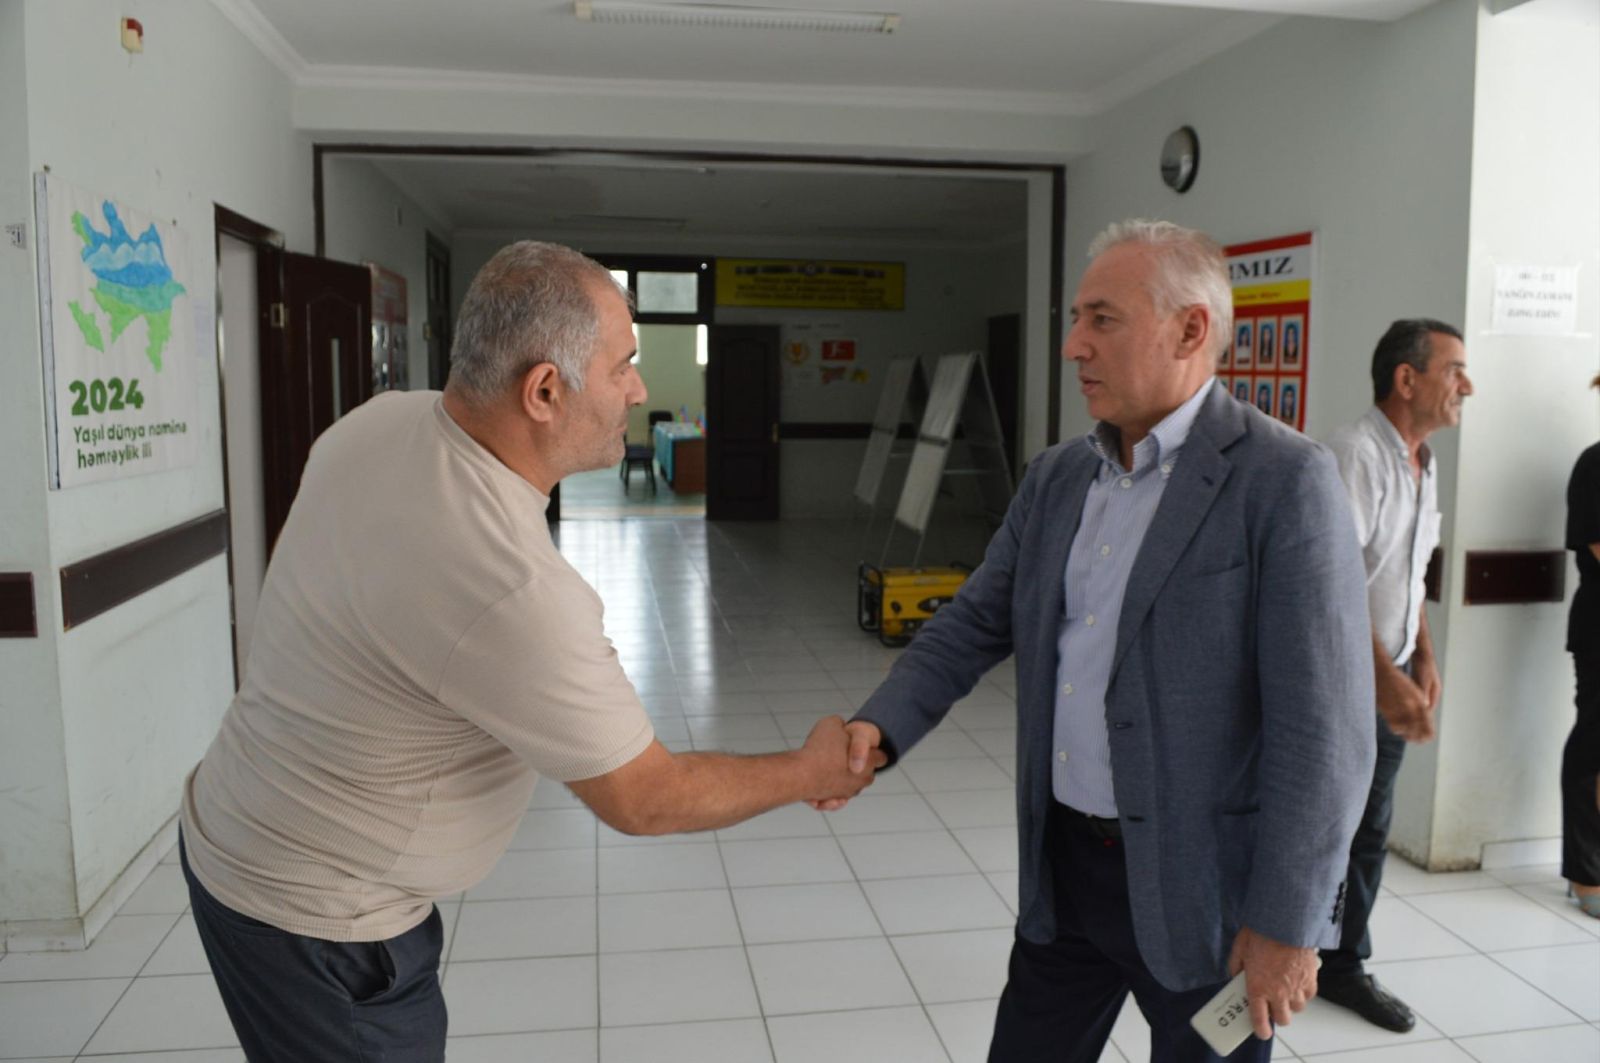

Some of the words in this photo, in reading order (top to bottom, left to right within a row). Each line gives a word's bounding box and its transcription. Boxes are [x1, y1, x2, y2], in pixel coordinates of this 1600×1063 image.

[69, 377, 144, 416] 2024
[73, 425, 104, 446] Yaşıl
[107, 424, 146, 442] dünya
[149, 420, 187, 436] naminə
[78, 444, 139, 469] həmrəylik
[142, 442, 152, 459] ili
